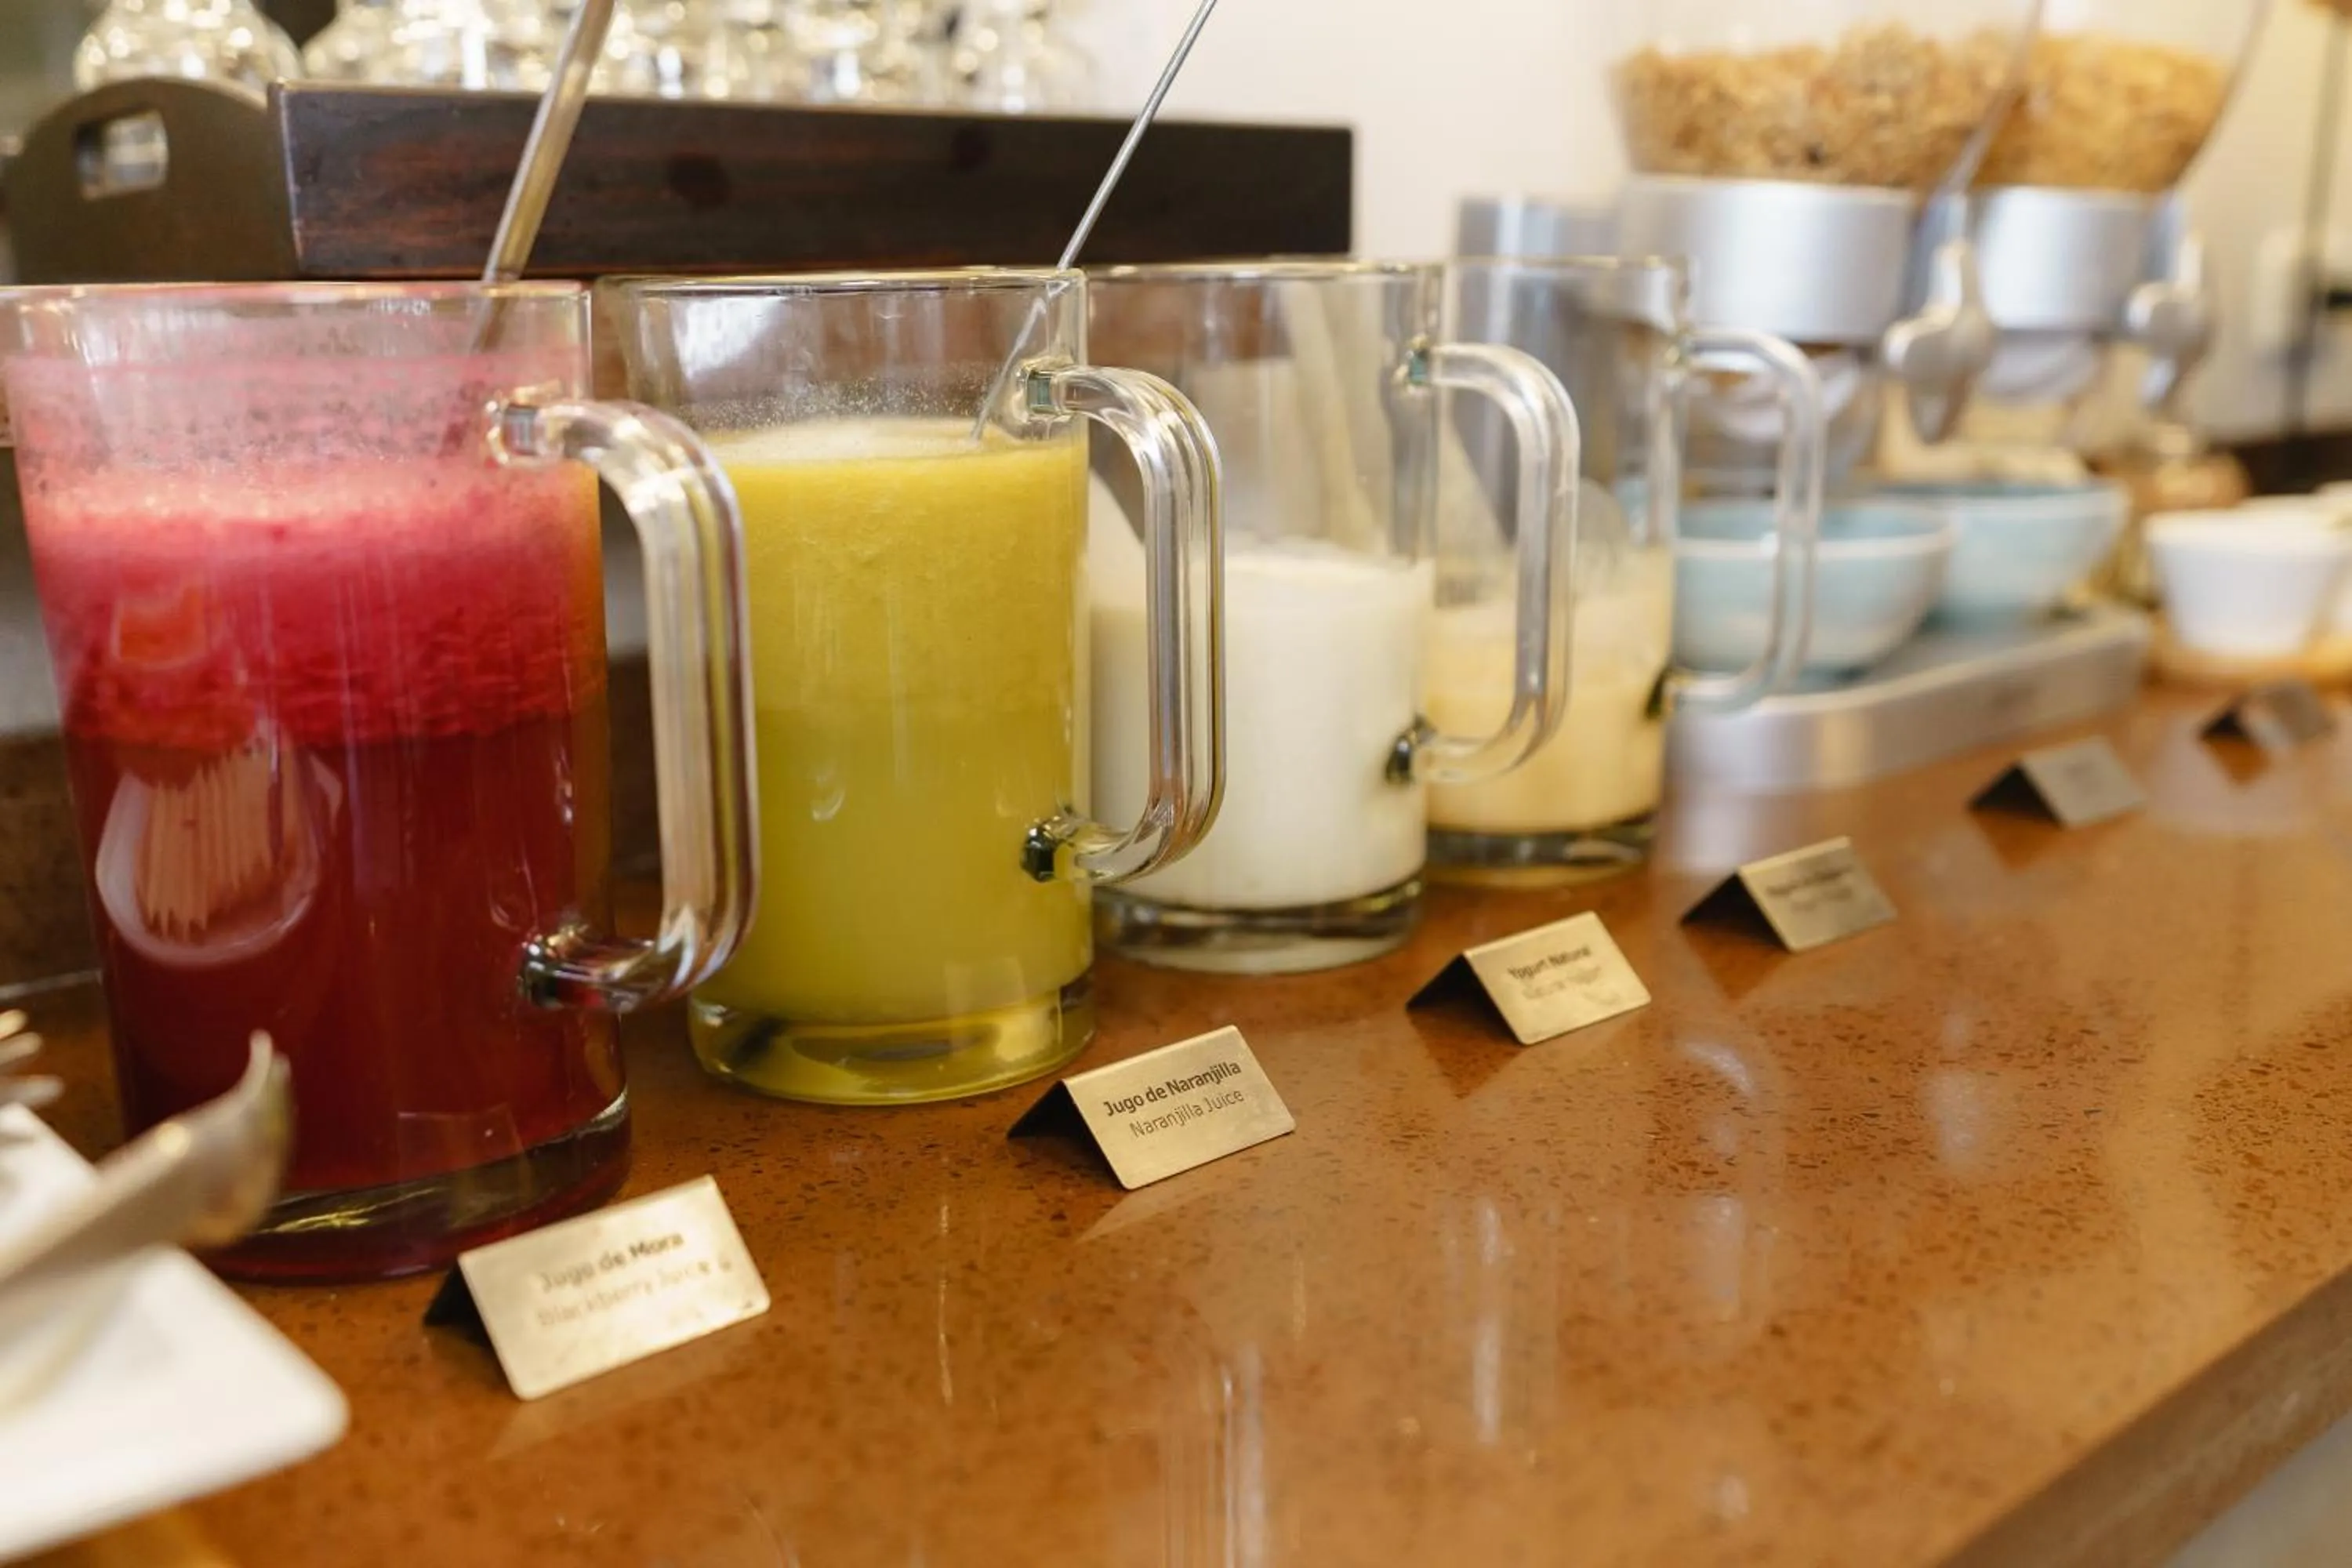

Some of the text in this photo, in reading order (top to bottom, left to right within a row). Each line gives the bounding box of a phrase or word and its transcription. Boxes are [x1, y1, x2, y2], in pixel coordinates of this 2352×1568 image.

[1103, 1062, 1243, 1117] Jugo de Naranjilla
[1129, 1089, 1245, 1138] Naranjilla Juice
[539, 1232, 684, 1294] Jugo de Mora
